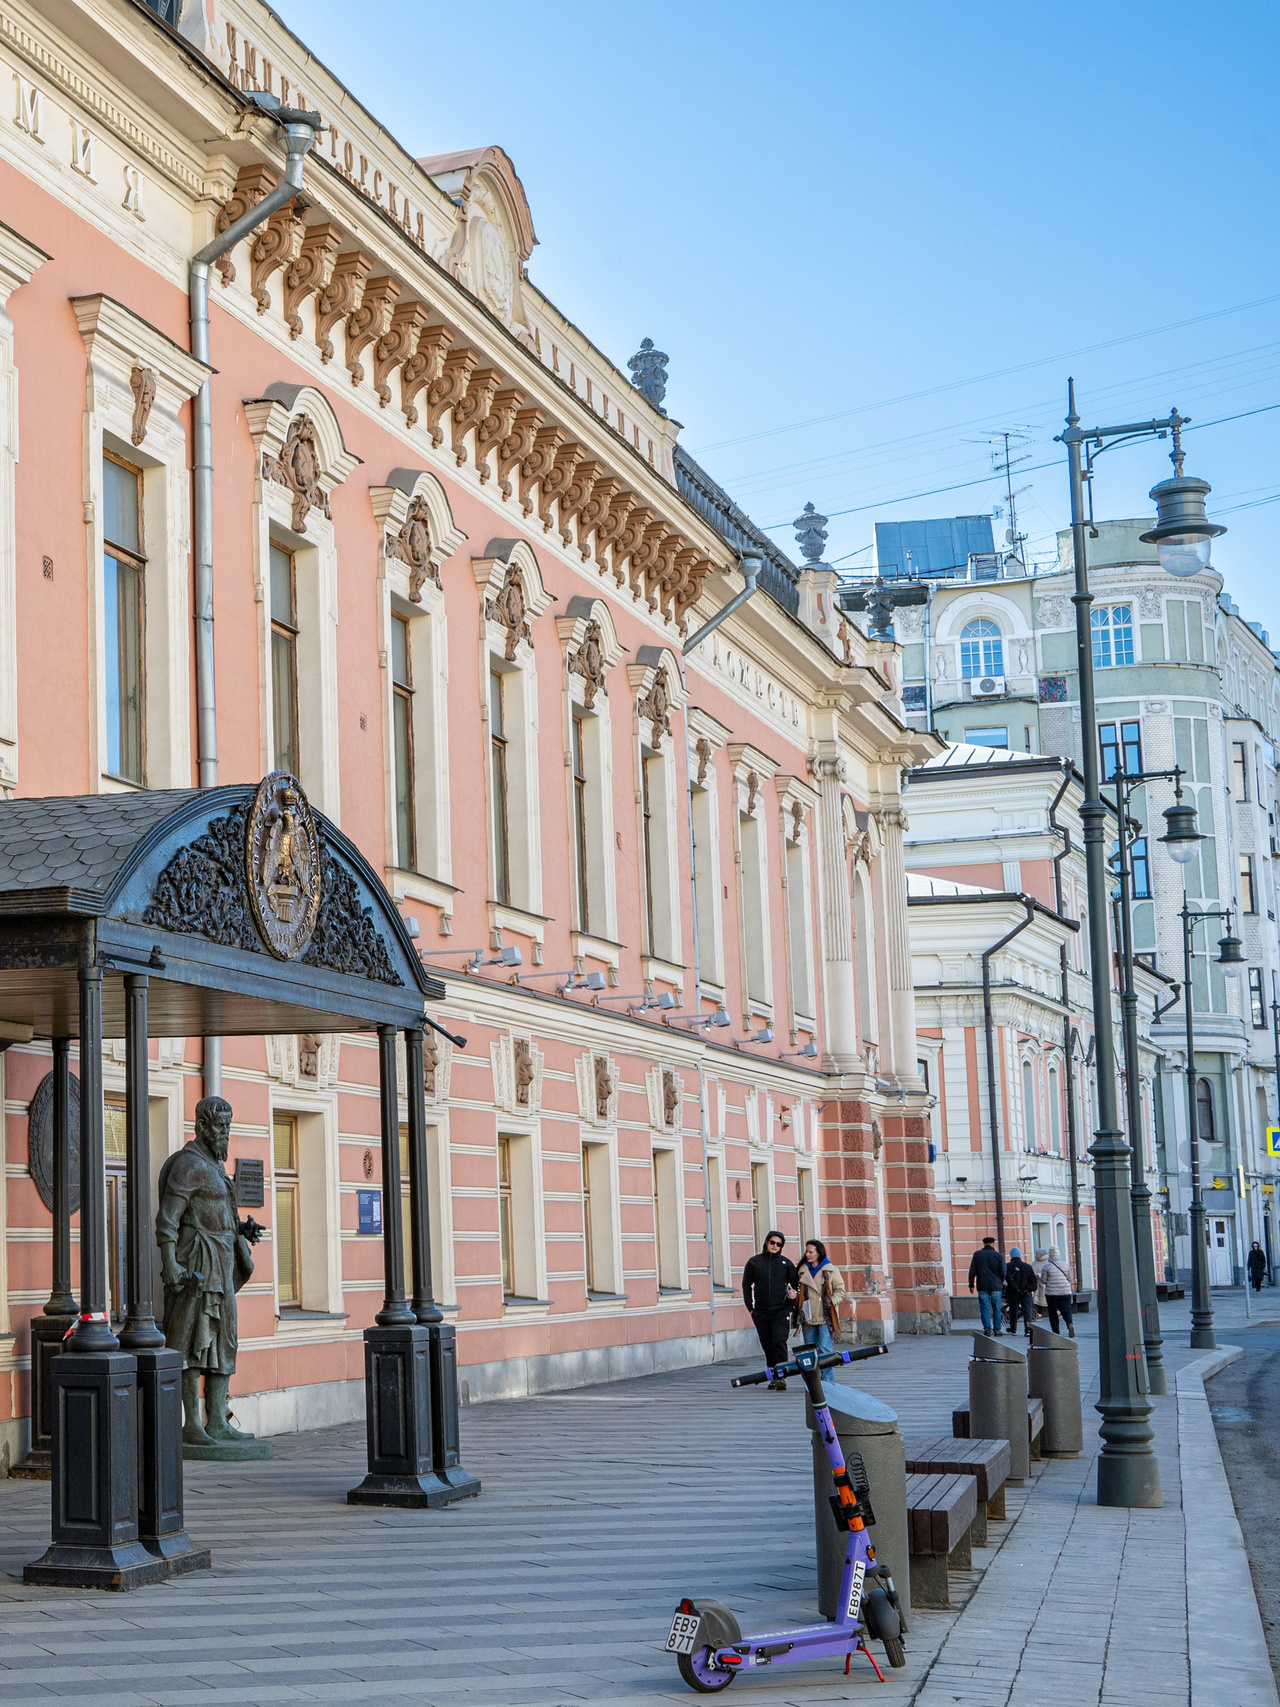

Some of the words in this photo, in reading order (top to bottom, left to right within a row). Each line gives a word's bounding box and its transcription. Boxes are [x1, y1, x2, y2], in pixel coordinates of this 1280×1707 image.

[686, 614, 799, 727] ДОЖЕСТВ
[849, 1562, 864, 1616] EB987T
[668, 1633, 694, 1651] 87T
[673, 1616, 697, 1634] EB9
